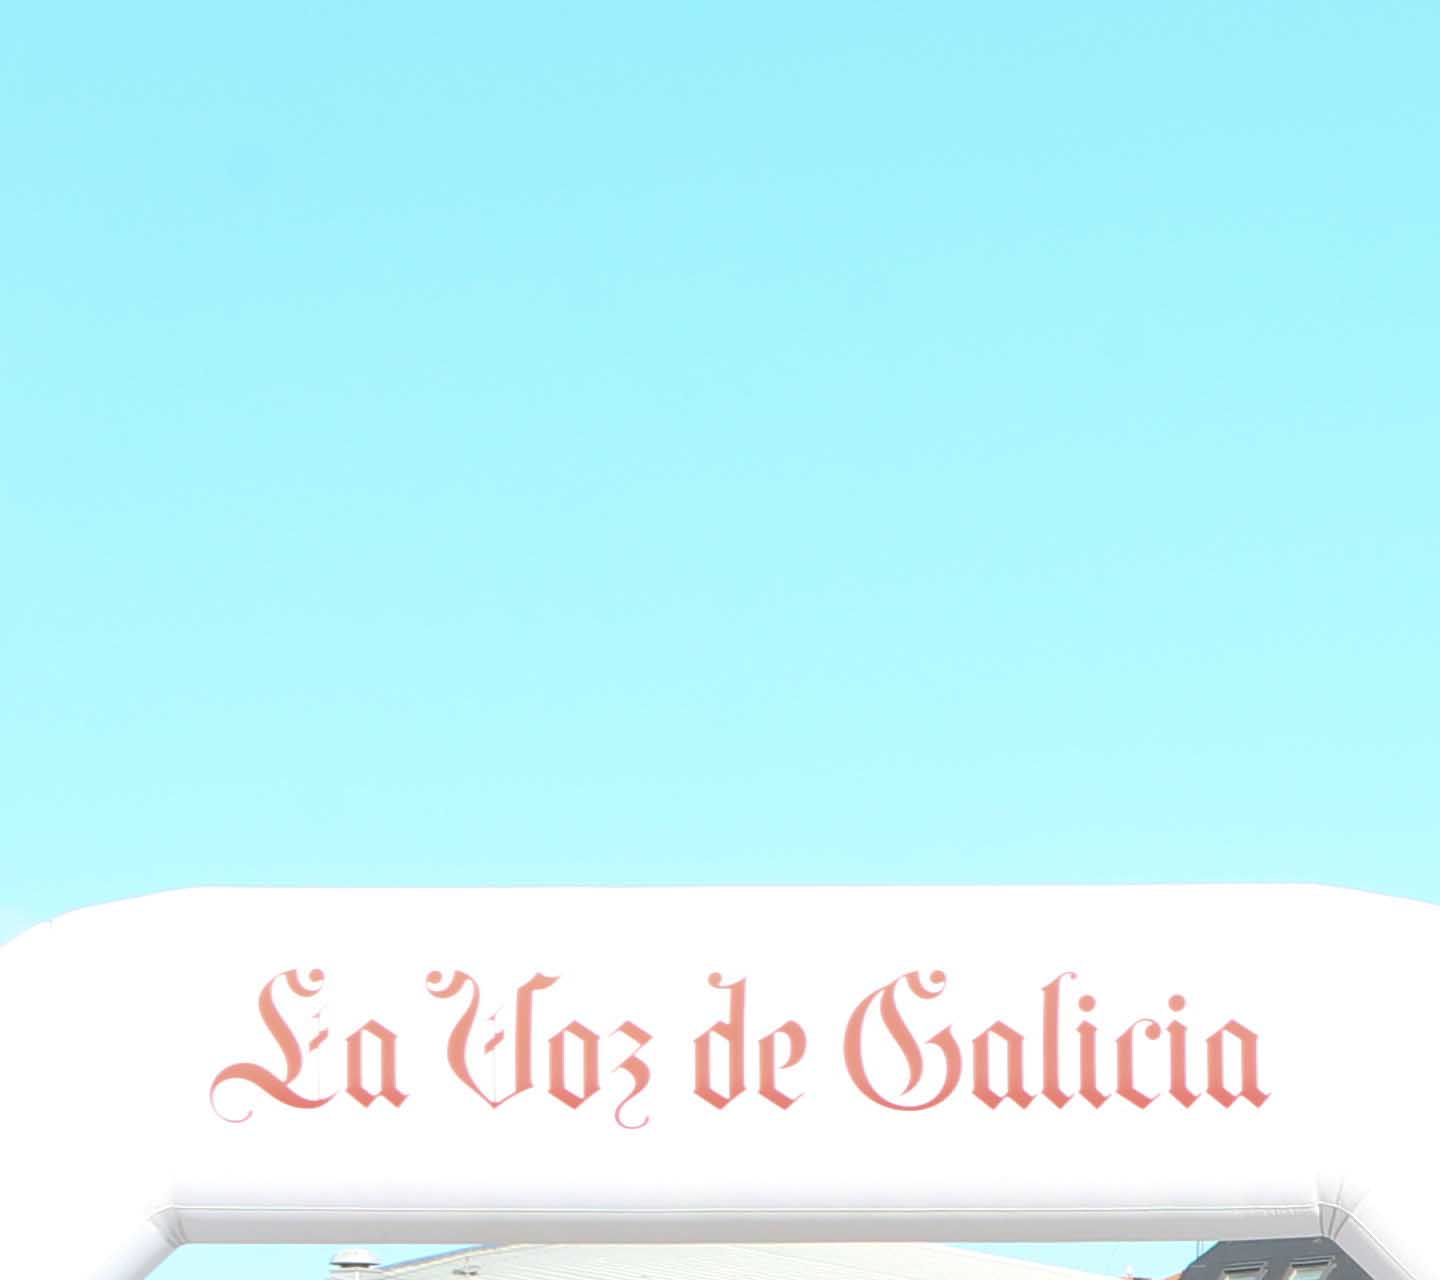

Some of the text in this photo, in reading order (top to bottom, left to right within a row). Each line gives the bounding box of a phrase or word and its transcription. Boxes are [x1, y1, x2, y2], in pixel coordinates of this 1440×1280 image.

[210, 967, 1272, 1130] La Voz de Galicia
